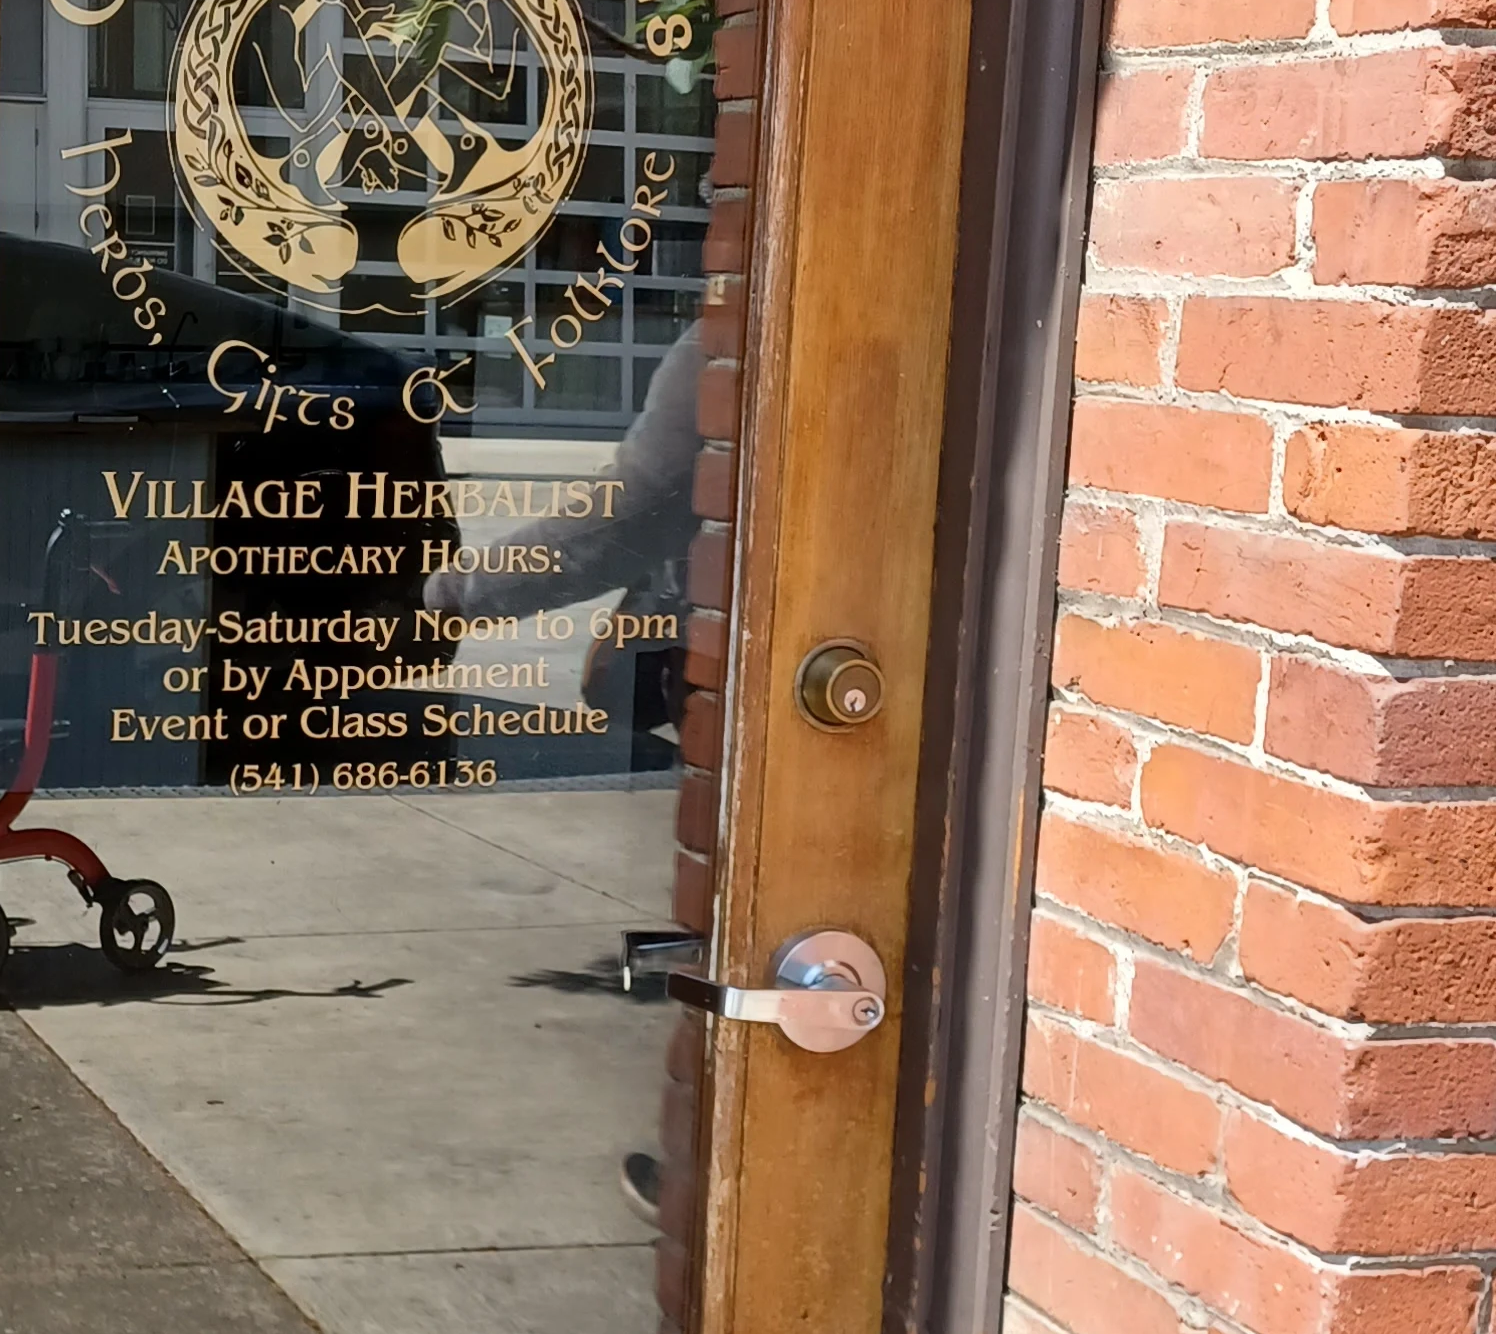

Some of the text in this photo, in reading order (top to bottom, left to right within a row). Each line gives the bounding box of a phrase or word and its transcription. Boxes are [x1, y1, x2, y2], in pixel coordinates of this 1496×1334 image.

[102, 472, 625, 520] VILLAGE HERBALIST
[156, 539, 563, 575] APOTHECARY HOURS:
[27, 606, 678, 653] Tuesday-Saturday Noon to 6pm
[163, 656, 549, 699] or by Appointment
[110, 703, 608, 742] Event or Class Schedule
[229, 759, 497, 796] (541) 686-6136
